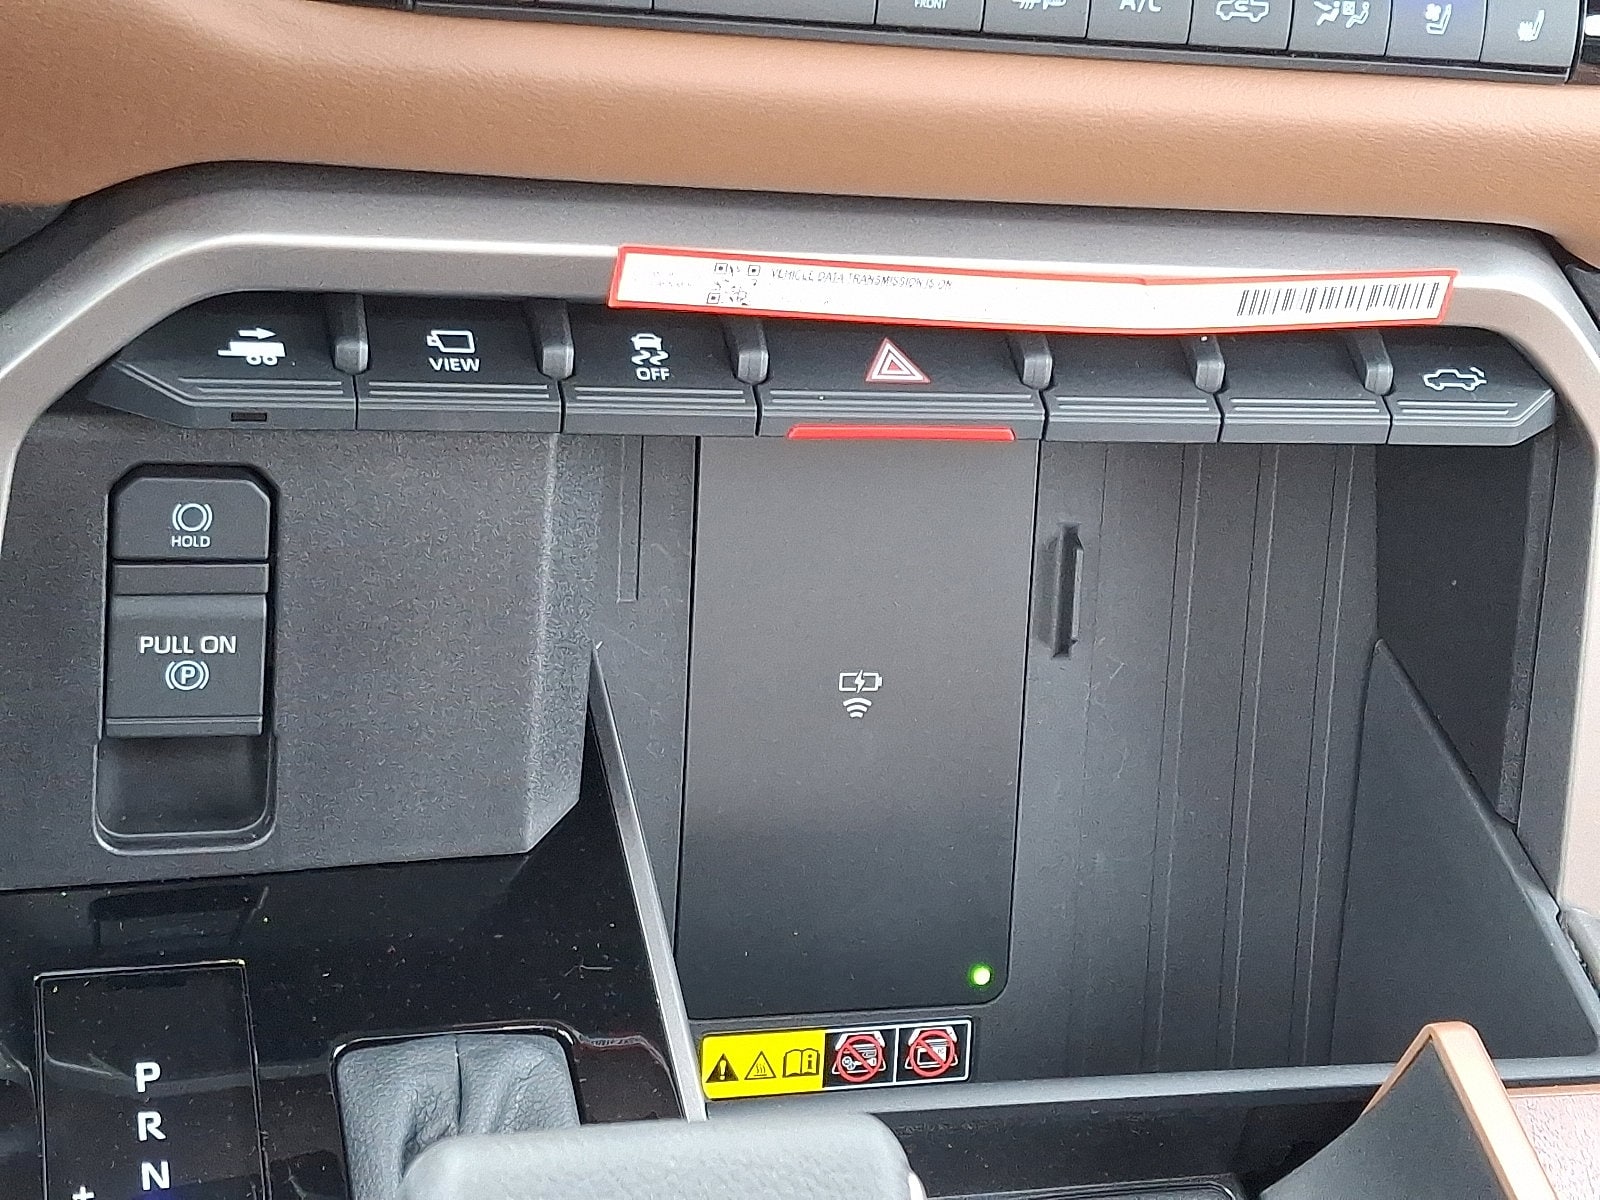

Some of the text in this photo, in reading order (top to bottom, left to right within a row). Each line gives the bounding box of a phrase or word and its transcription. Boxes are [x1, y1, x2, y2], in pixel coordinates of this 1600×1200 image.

[1119, 0, 1162, 12] A/C
[770, 267, 814, 283] VEHICLE
[817, 270, 845, 284] DATA
[848, 272, 923, 288] TRANSMISSION
[925, 278, 935, 289] IS
[428, 357, 480, 372] VIEW
[634, 367, 670, 381] OFF
[171, 535, 211, 548] HOLD
[139, 635, 237, 654] PULL ON
[179, 664, 196, 685] P
[135, 1061, 161, 1093] P
[137, 1111, 167, 1142] R
[141, 1160, 171, 1191] N
